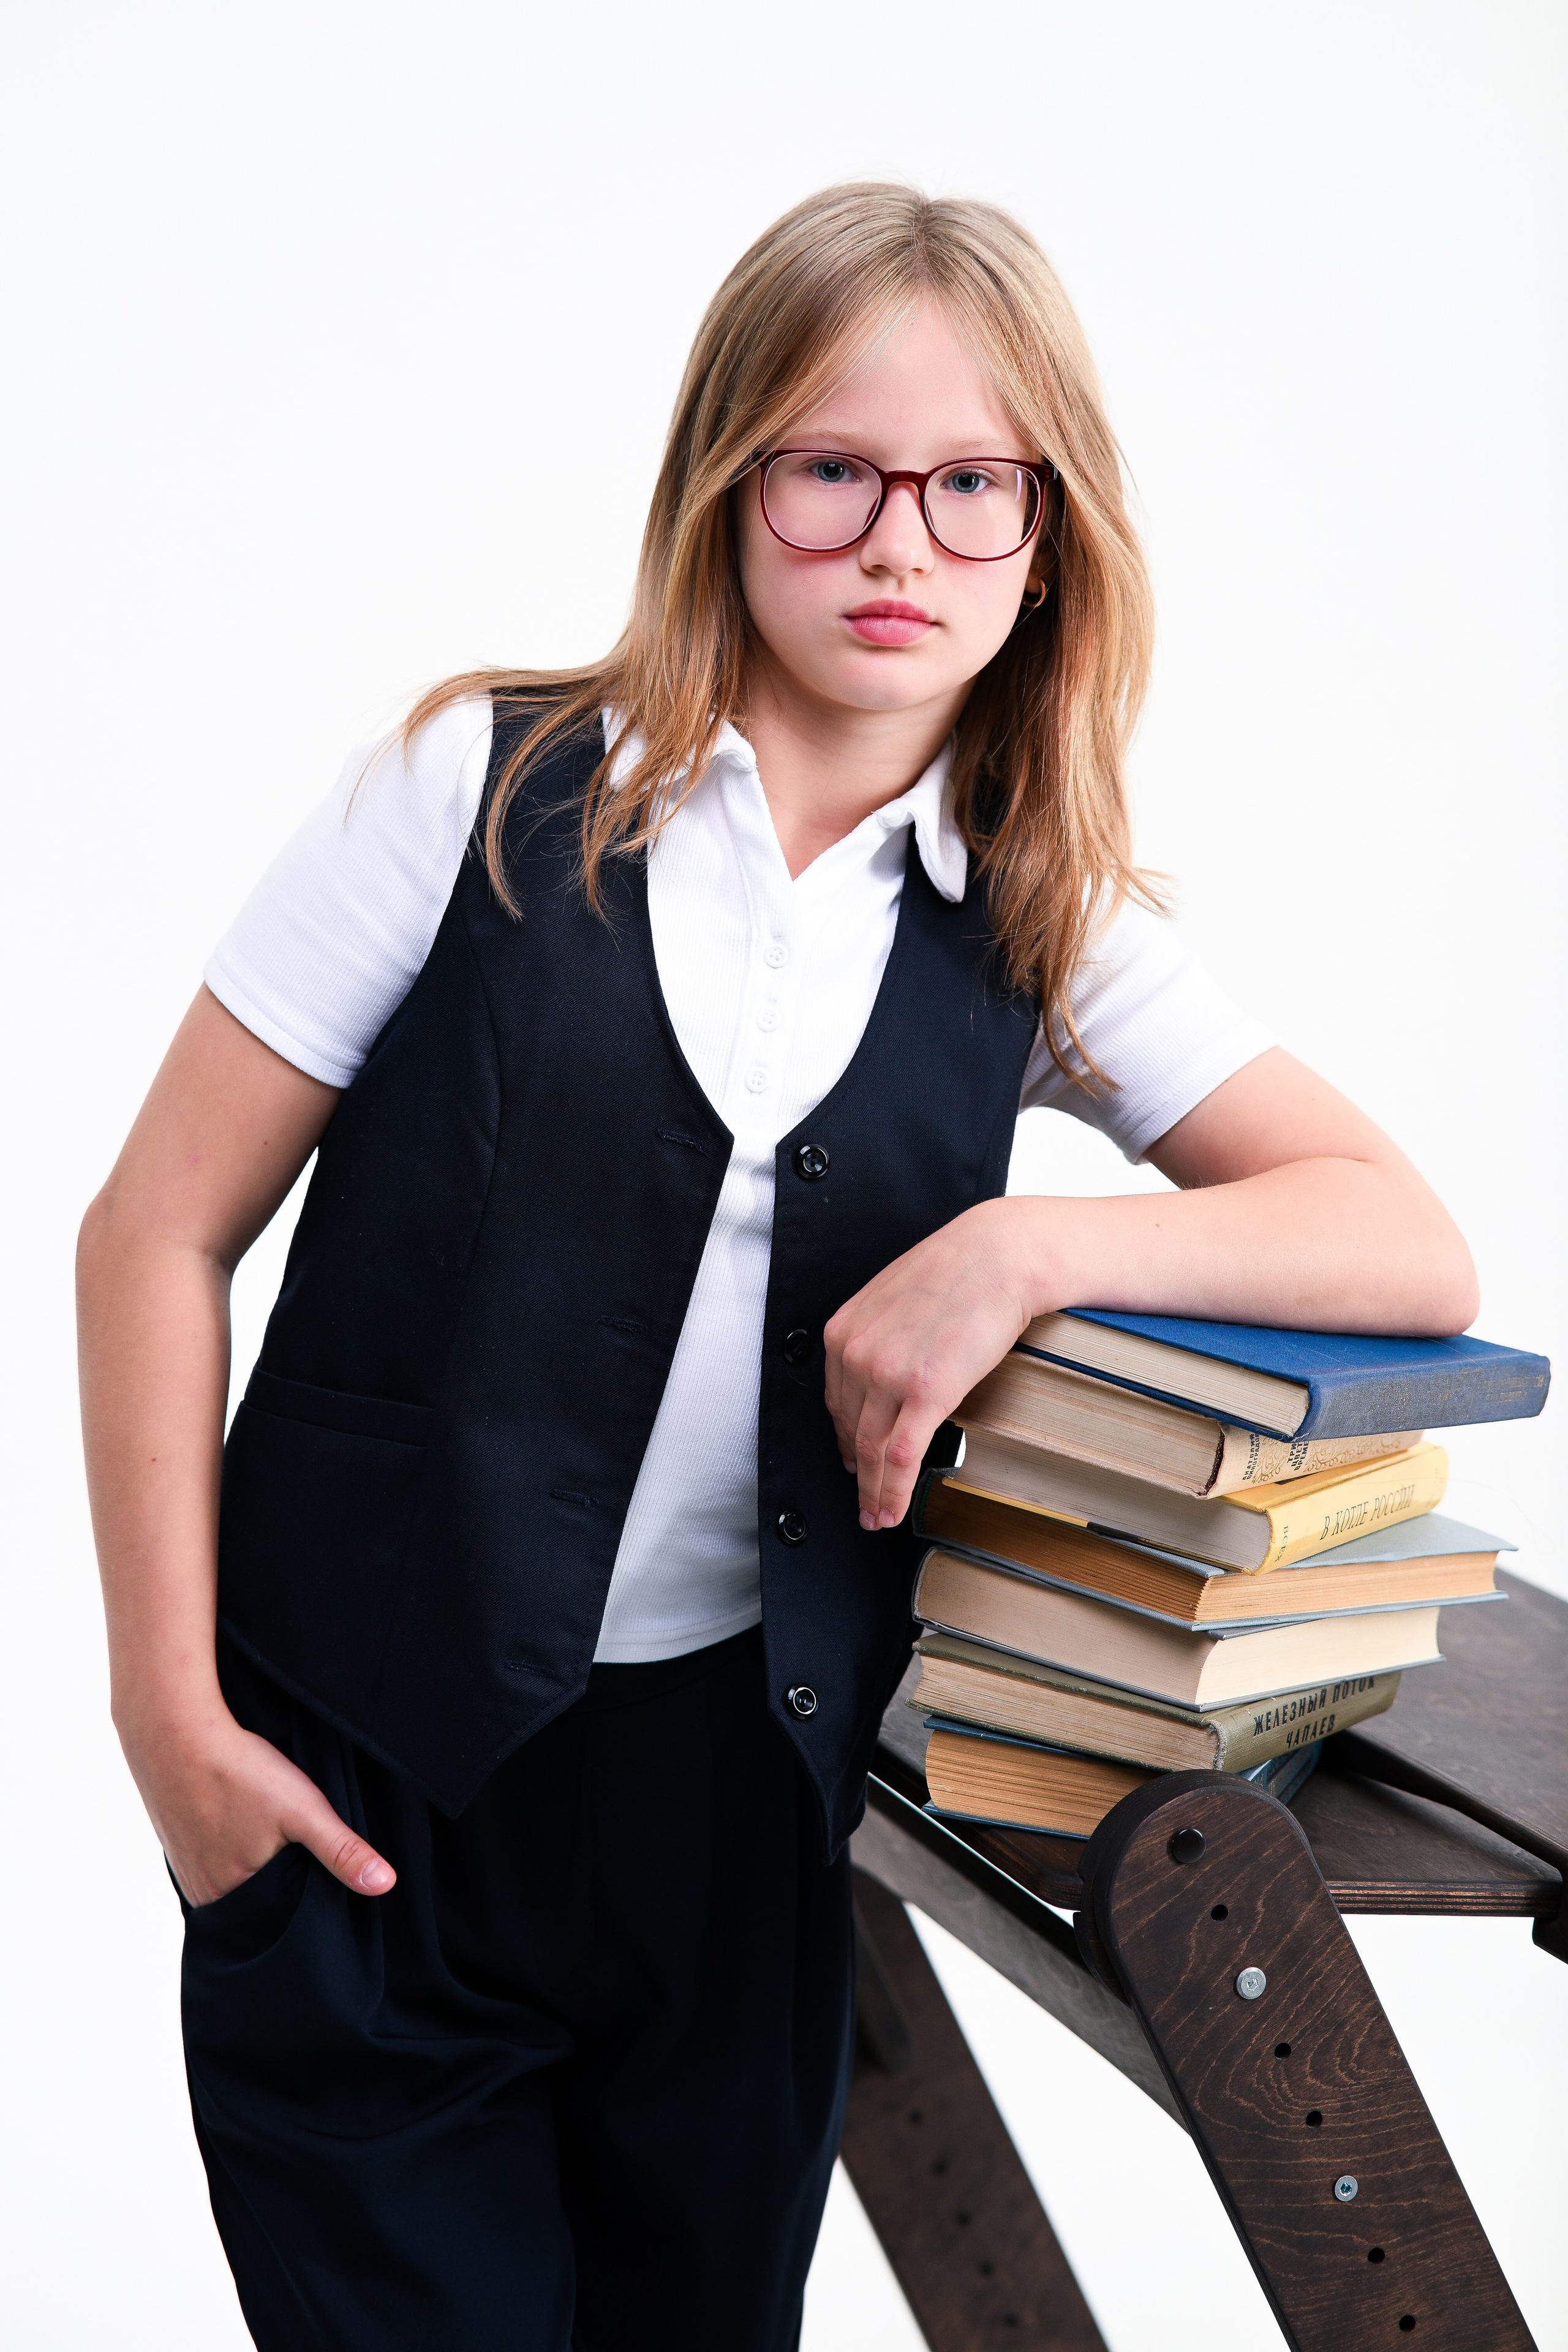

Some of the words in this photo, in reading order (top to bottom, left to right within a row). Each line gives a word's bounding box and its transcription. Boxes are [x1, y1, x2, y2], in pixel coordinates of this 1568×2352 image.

[1242, 1434, 1254, 1480] АНАТОЛИЙ
[1287, 1442, 1297, 1463] ТРИ
[1319, 1516, 1330, 1540] В
[1331, 1501, 1369, 1536] КОТЛЕ
[1370, 1484, 1415, 1521] РОССИИ
[1275, 1525, 1289, 1562] ВСЕХ
[1253, 1687, 1327, 1737] ЖЕЛЕЗНЫЙ
[1332, 1676, 1374, 1703] ПОТОК
[1286, 1714, 1335, 1749] ЧАПАЕВ
